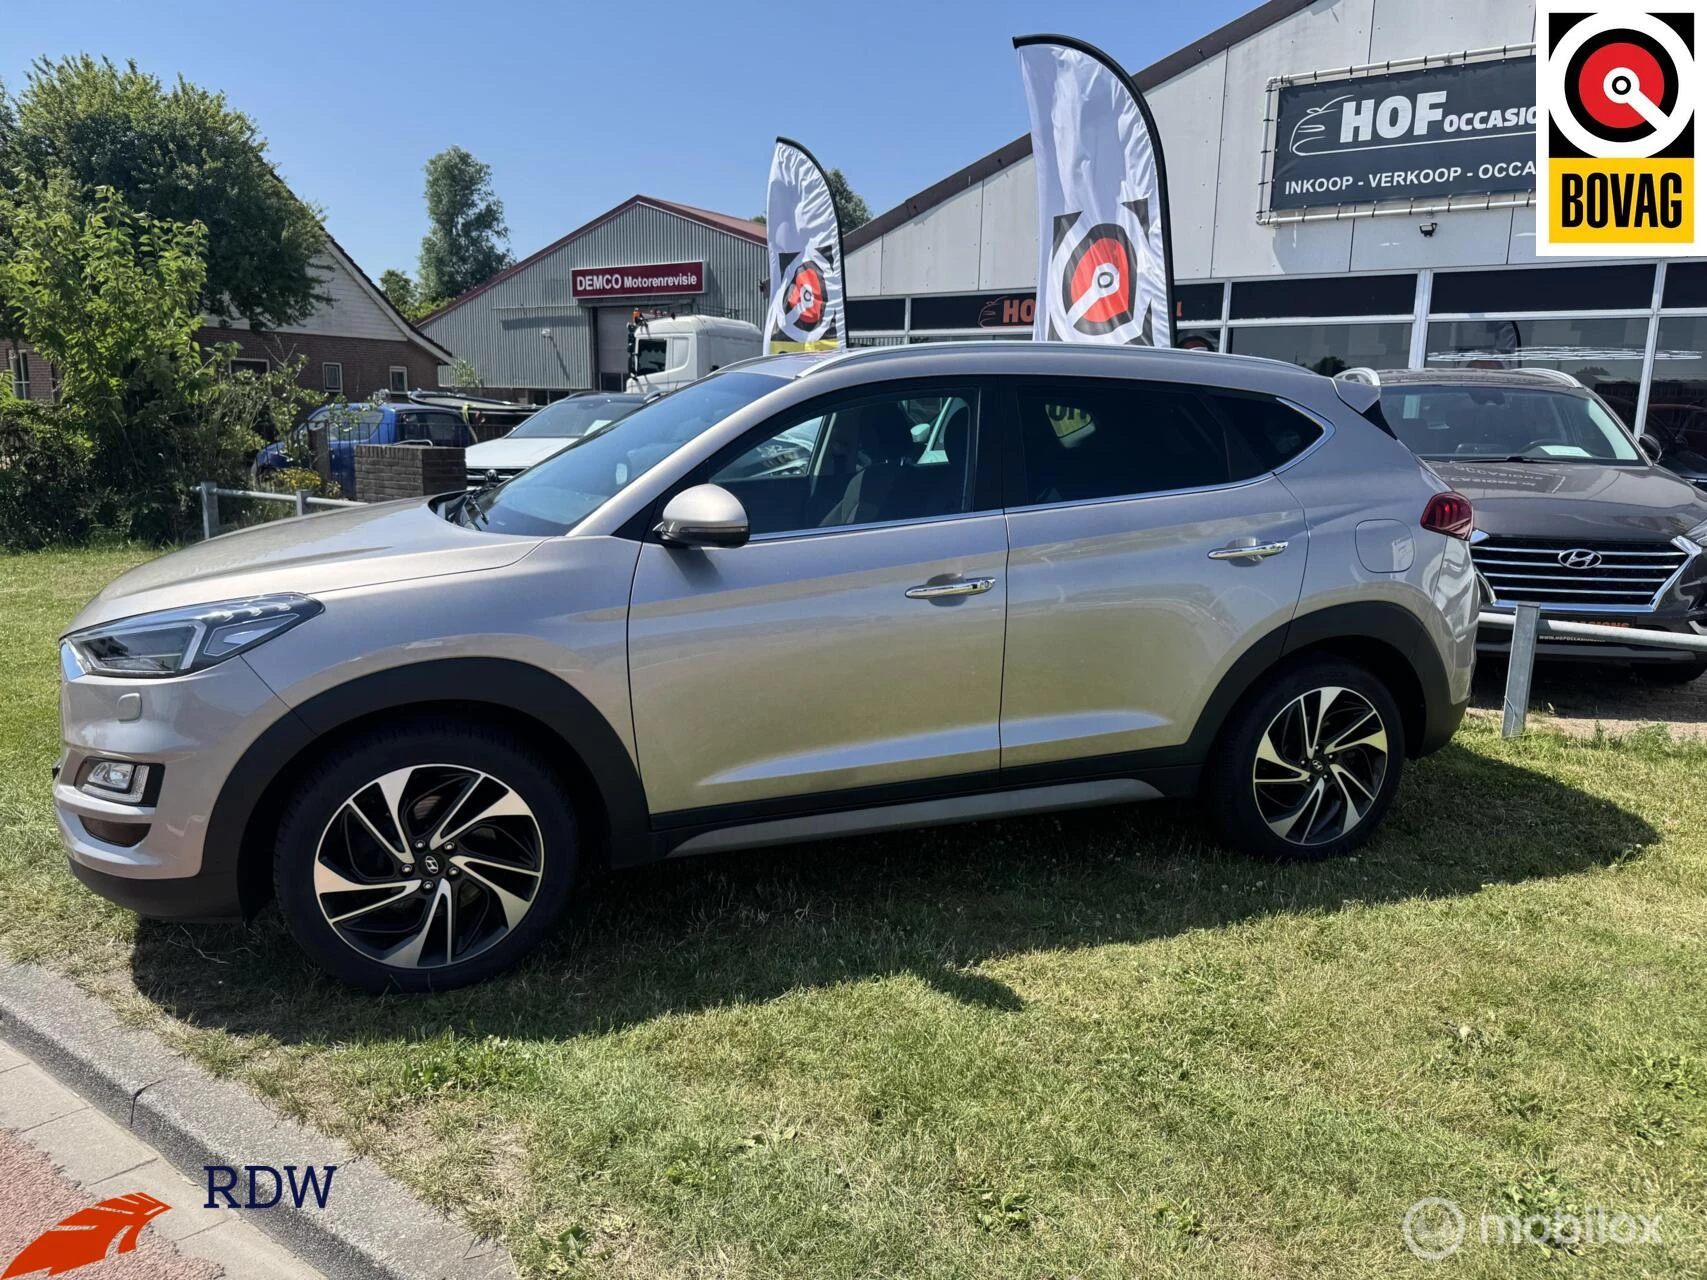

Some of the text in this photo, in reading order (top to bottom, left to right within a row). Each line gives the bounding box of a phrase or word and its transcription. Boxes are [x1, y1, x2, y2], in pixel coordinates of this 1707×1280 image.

[1339, 90, 1447, 143] HOF
[1285, 176, 1353, 195] INKOOP
[1368, 167, 1462, 188] VERKOOP
[576, 272, 697, 291] DEMCO Motorenrevisie
